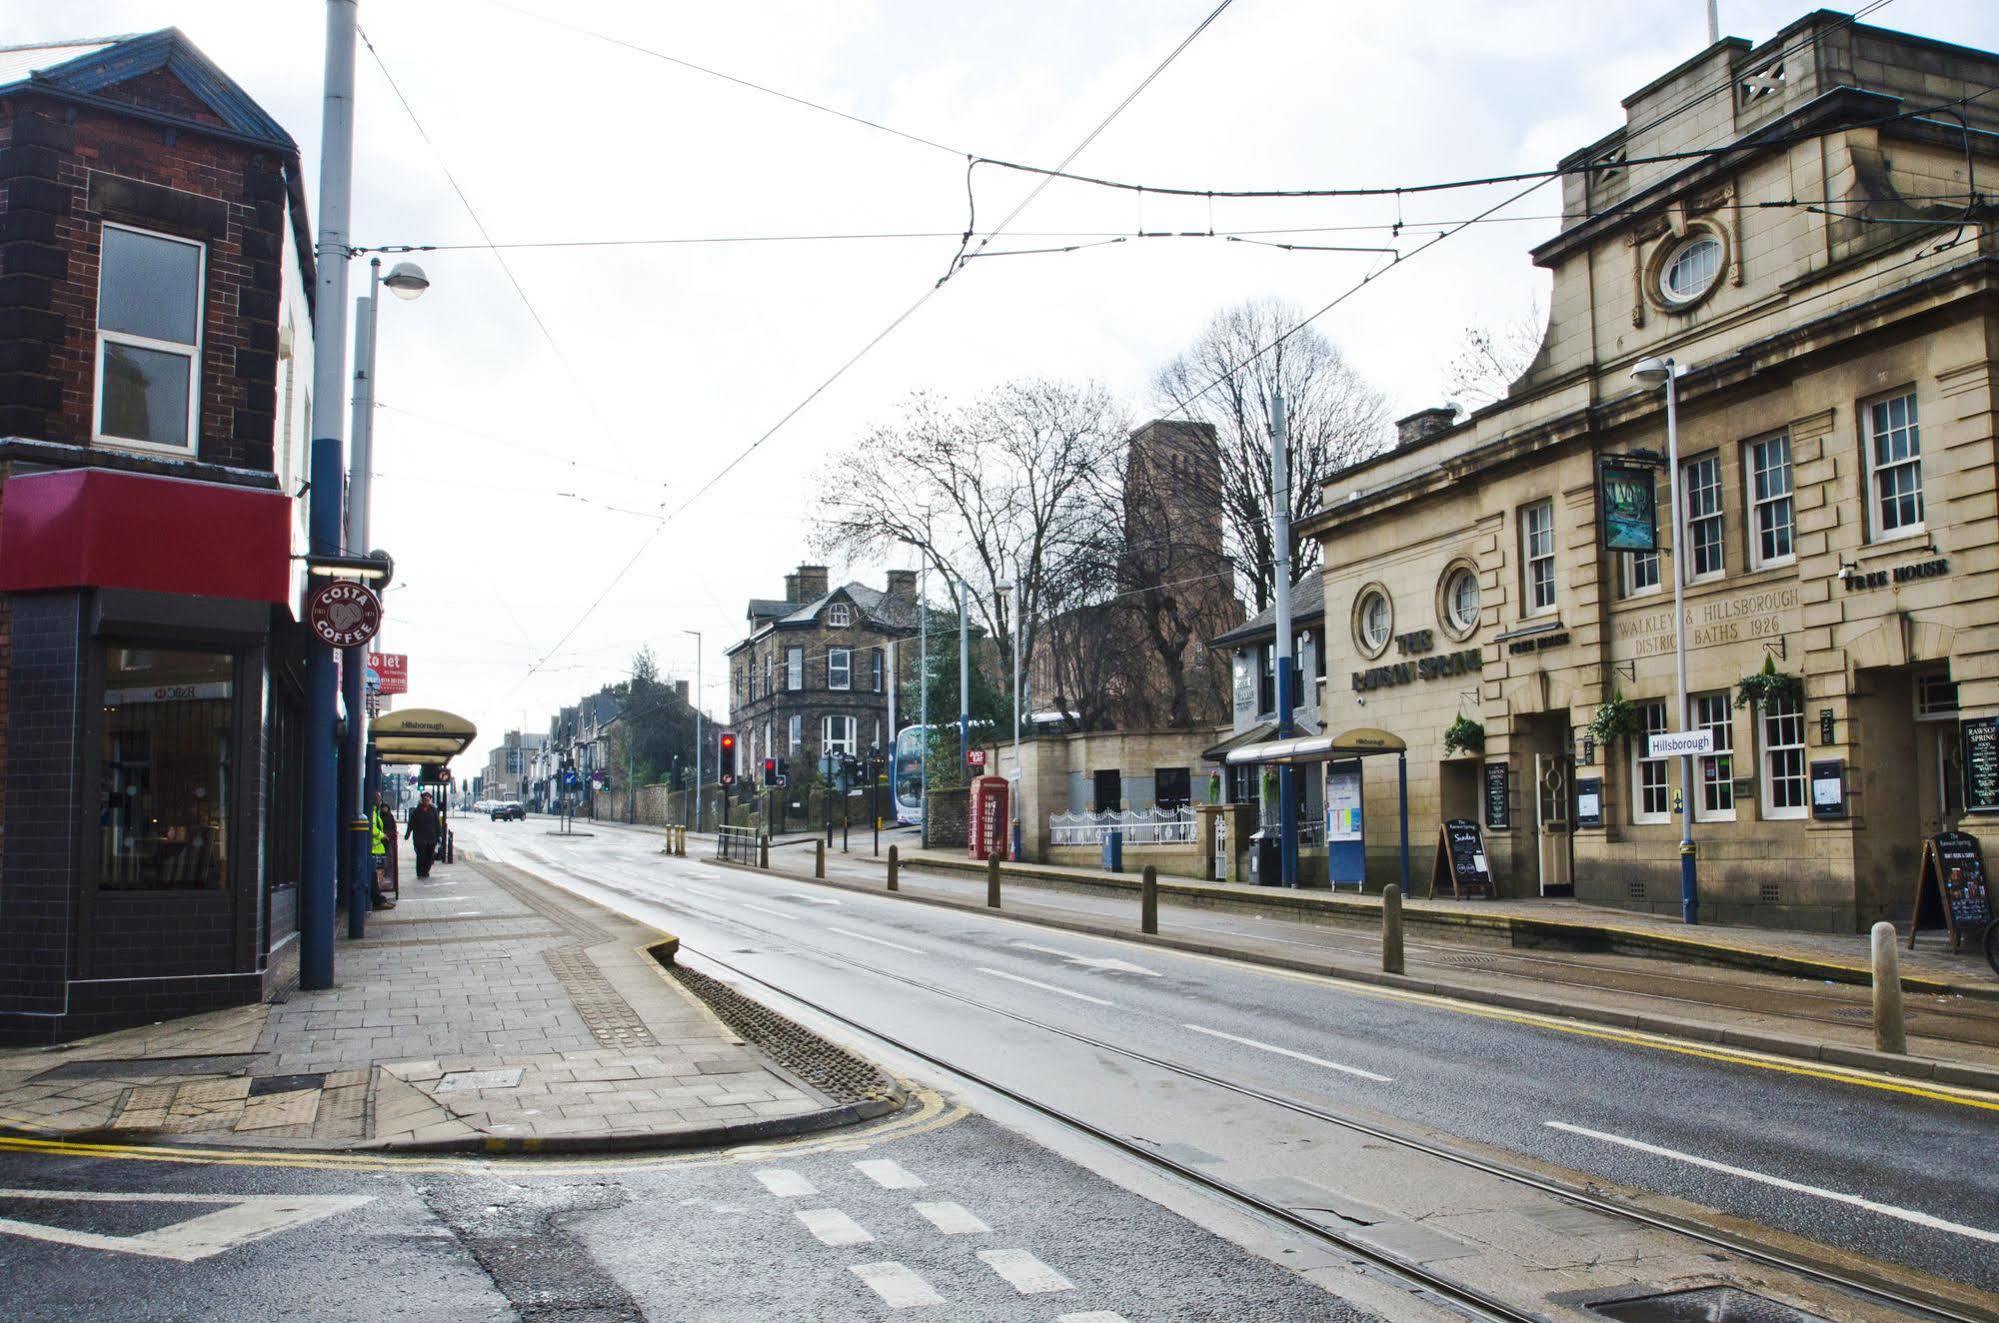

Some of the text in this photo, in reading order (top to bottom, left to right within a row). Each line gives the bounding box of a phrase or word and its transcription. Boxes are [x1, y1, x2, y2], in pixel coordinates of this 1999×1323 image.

[1893, 559, 1950, 582] HOUSE
[322, 587, 368, 606] COSTA
[1618, 588, 1799, 637] WALKLEY & HILLSBOROUGH
[317, 620, 372, 644] COFFEE
[1395, 629, 1434, 656] THE
[1635, 615, 1780, 655] DISTRIC BATHS 1926
[1509, 633, 1571, 655] FREE HOUSE
[383, 655, 401, 668] let
[402, 721, 444, 730] Hillsborough
[1653, 735, 1710, 752] Hillsborough
